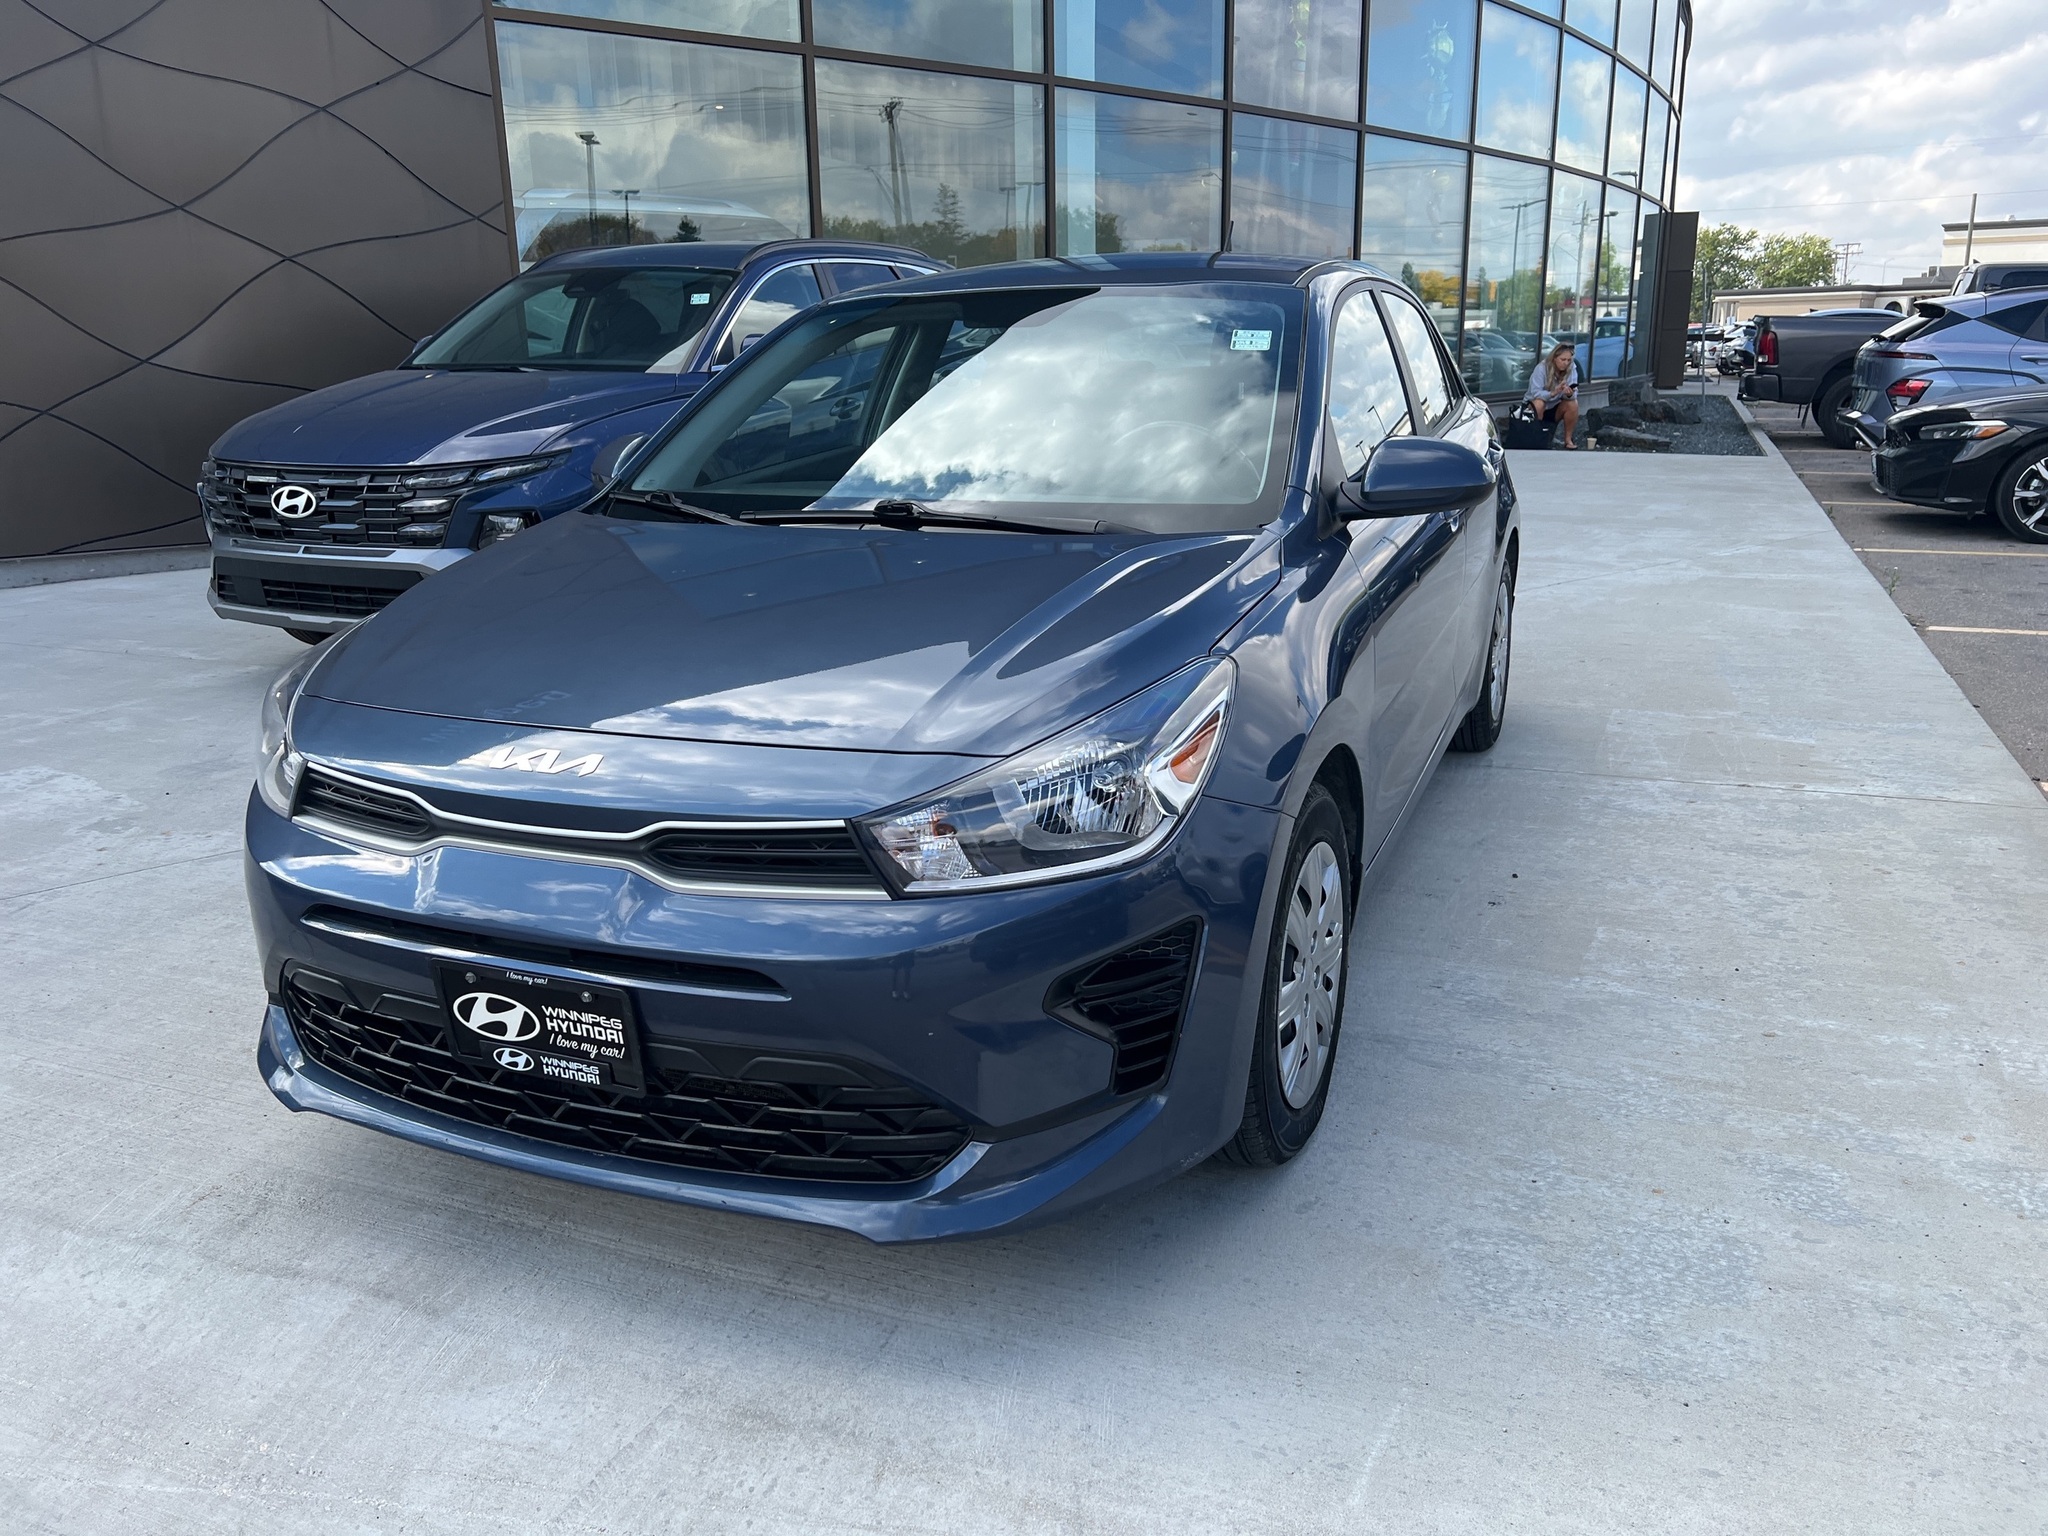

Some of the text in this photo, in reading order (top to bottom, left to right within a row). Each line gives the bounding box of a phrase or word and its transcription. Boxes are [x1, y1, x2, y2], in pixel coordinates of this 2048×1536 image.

[510, 971, 523, 981] love
[523, 976, 533, 985] my
[534, 977, 548, 985] car!
[541, 1005, 623, 1030] WINNIPEG
[545, 1017, 624, 1045] HYUNDAI
[549, 1033, 625, 1059] I love my car!
[540, 1055, 600, 1075] WINNIPEG
[543, 1064, 600, 1085] HYUNDAI
